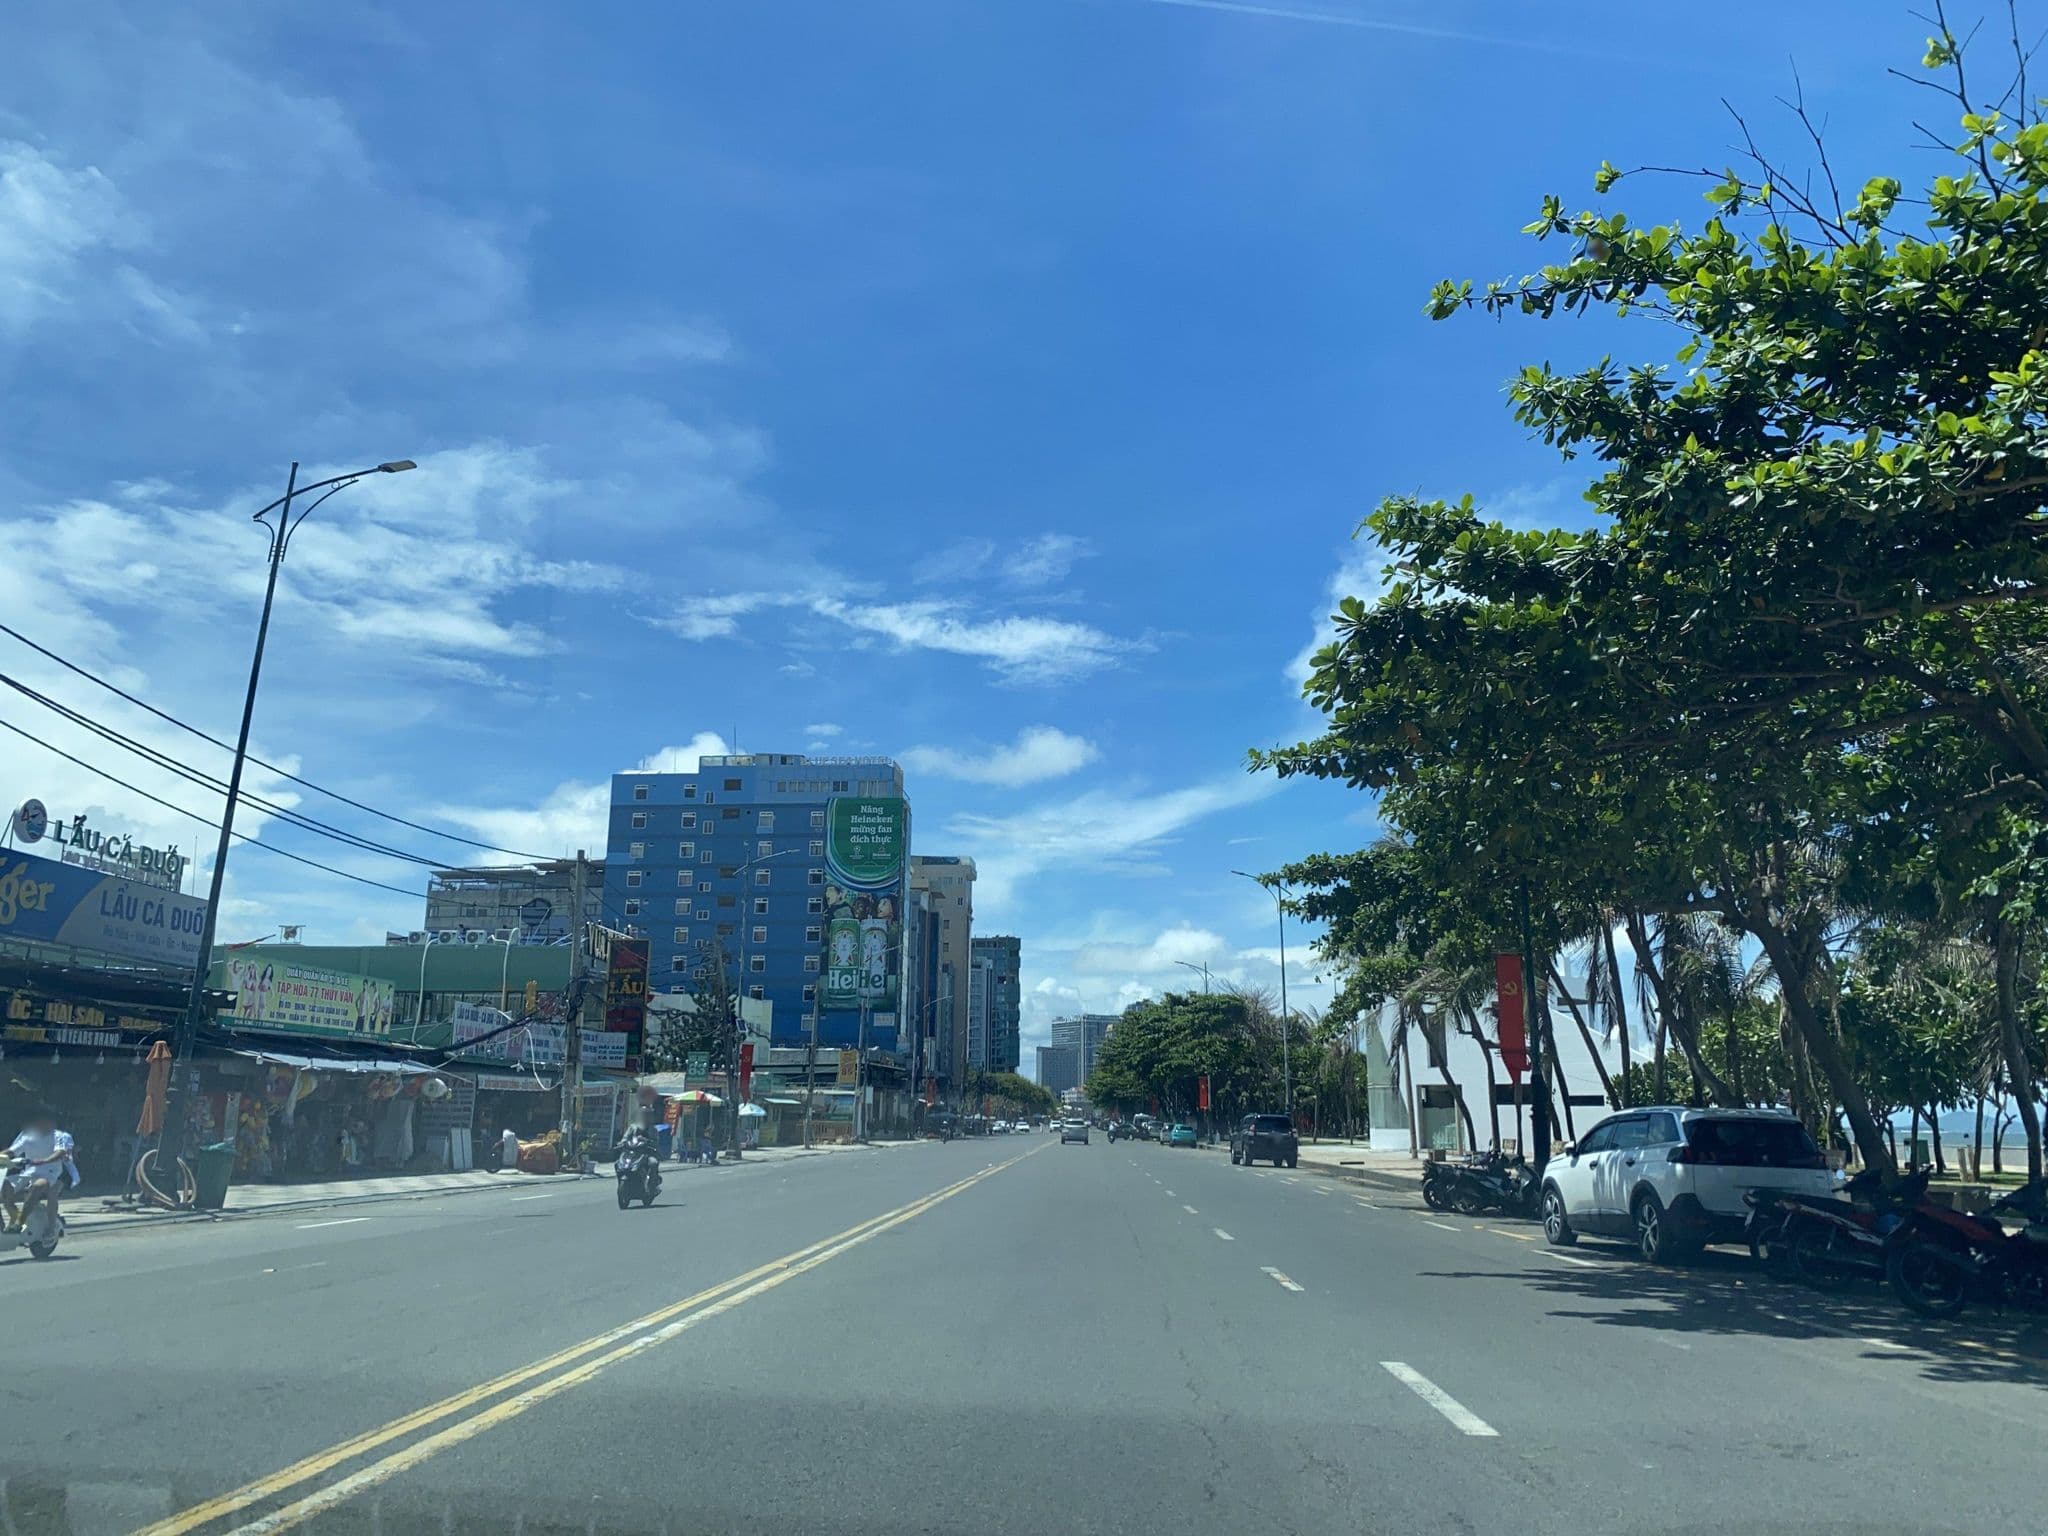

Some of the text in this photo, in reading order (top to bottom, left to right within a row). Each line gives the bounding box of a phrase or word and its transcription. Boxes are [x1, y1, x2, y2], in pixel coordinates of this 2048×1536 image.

[850, 814, 893, 823] Heineken
[878, 825, 892, 833] fan
[871, 834, 892, 845] thực
[0, 857, 55, 925] ger
[100, 883, 138, 922] LẨU
[142, 897, 164, 928] CÁ
[171, 906, 207, 936] ĐUỐ
[608, 973, 645, 995] LẨU
